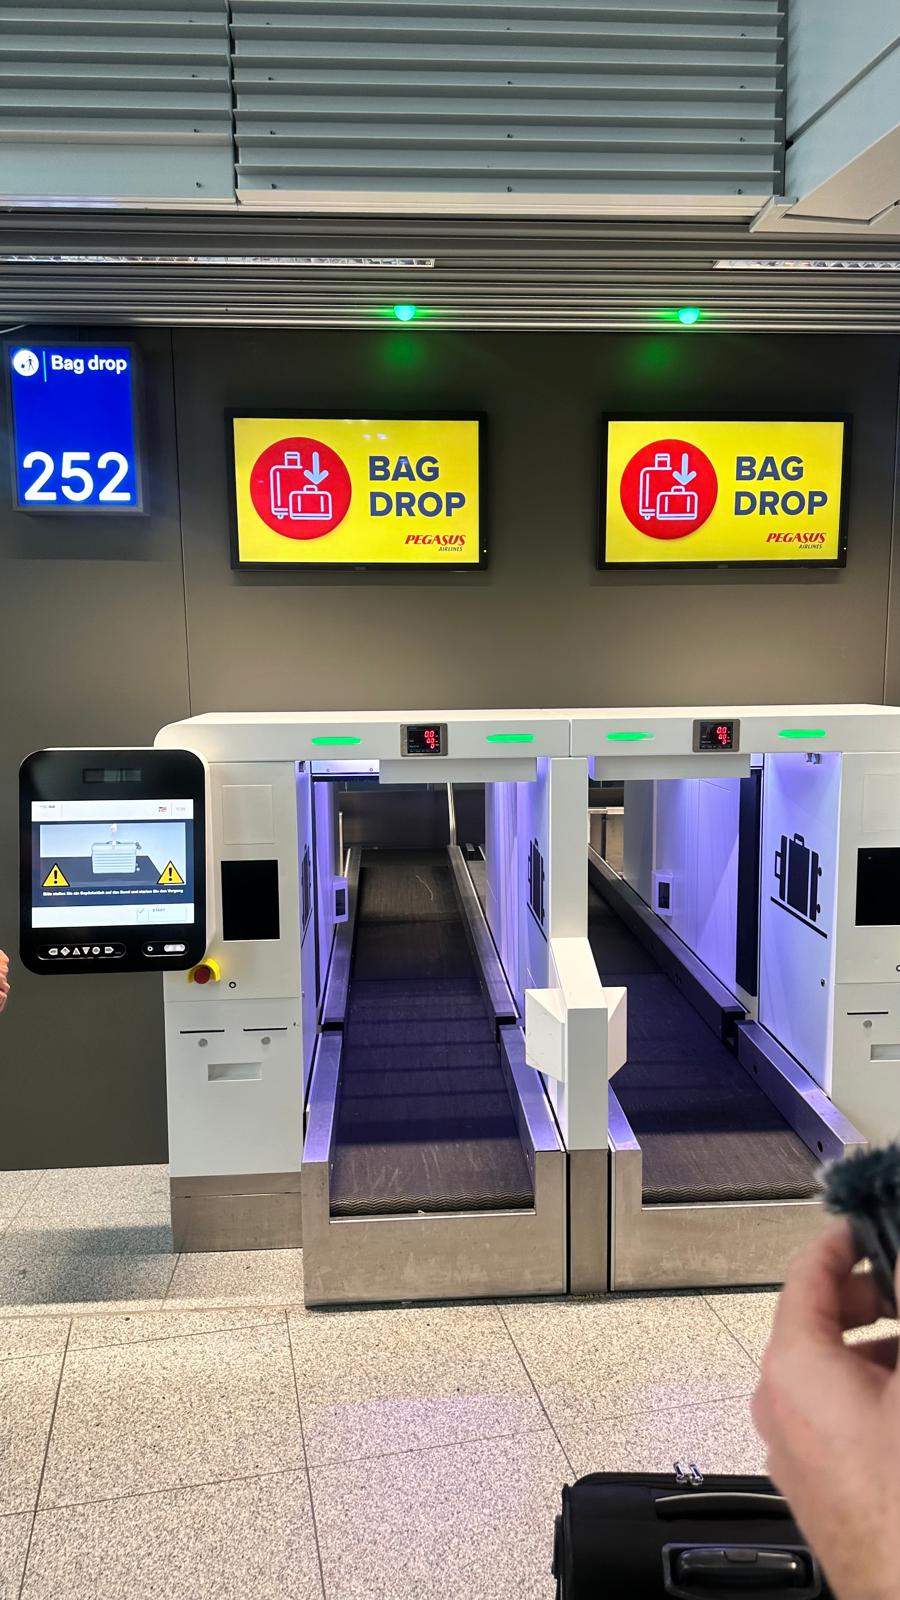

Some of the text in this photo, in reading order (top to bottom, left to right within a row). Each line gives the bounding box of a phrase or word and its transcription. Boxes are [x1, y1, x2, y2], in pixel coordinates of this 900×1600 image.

[51, 355, 128, 375] Bag drop
[23, 451, 131, 501] 252
[369, 455, 440, 482] BAG
[736, 456, 804, 481] BAG
[369, 491, 466, 517] DROP
[734, 491, 828, 516] DROP
[405, 534, 467, 546] PEGASUS
[766, 533, 826, 543] PEGASUS
